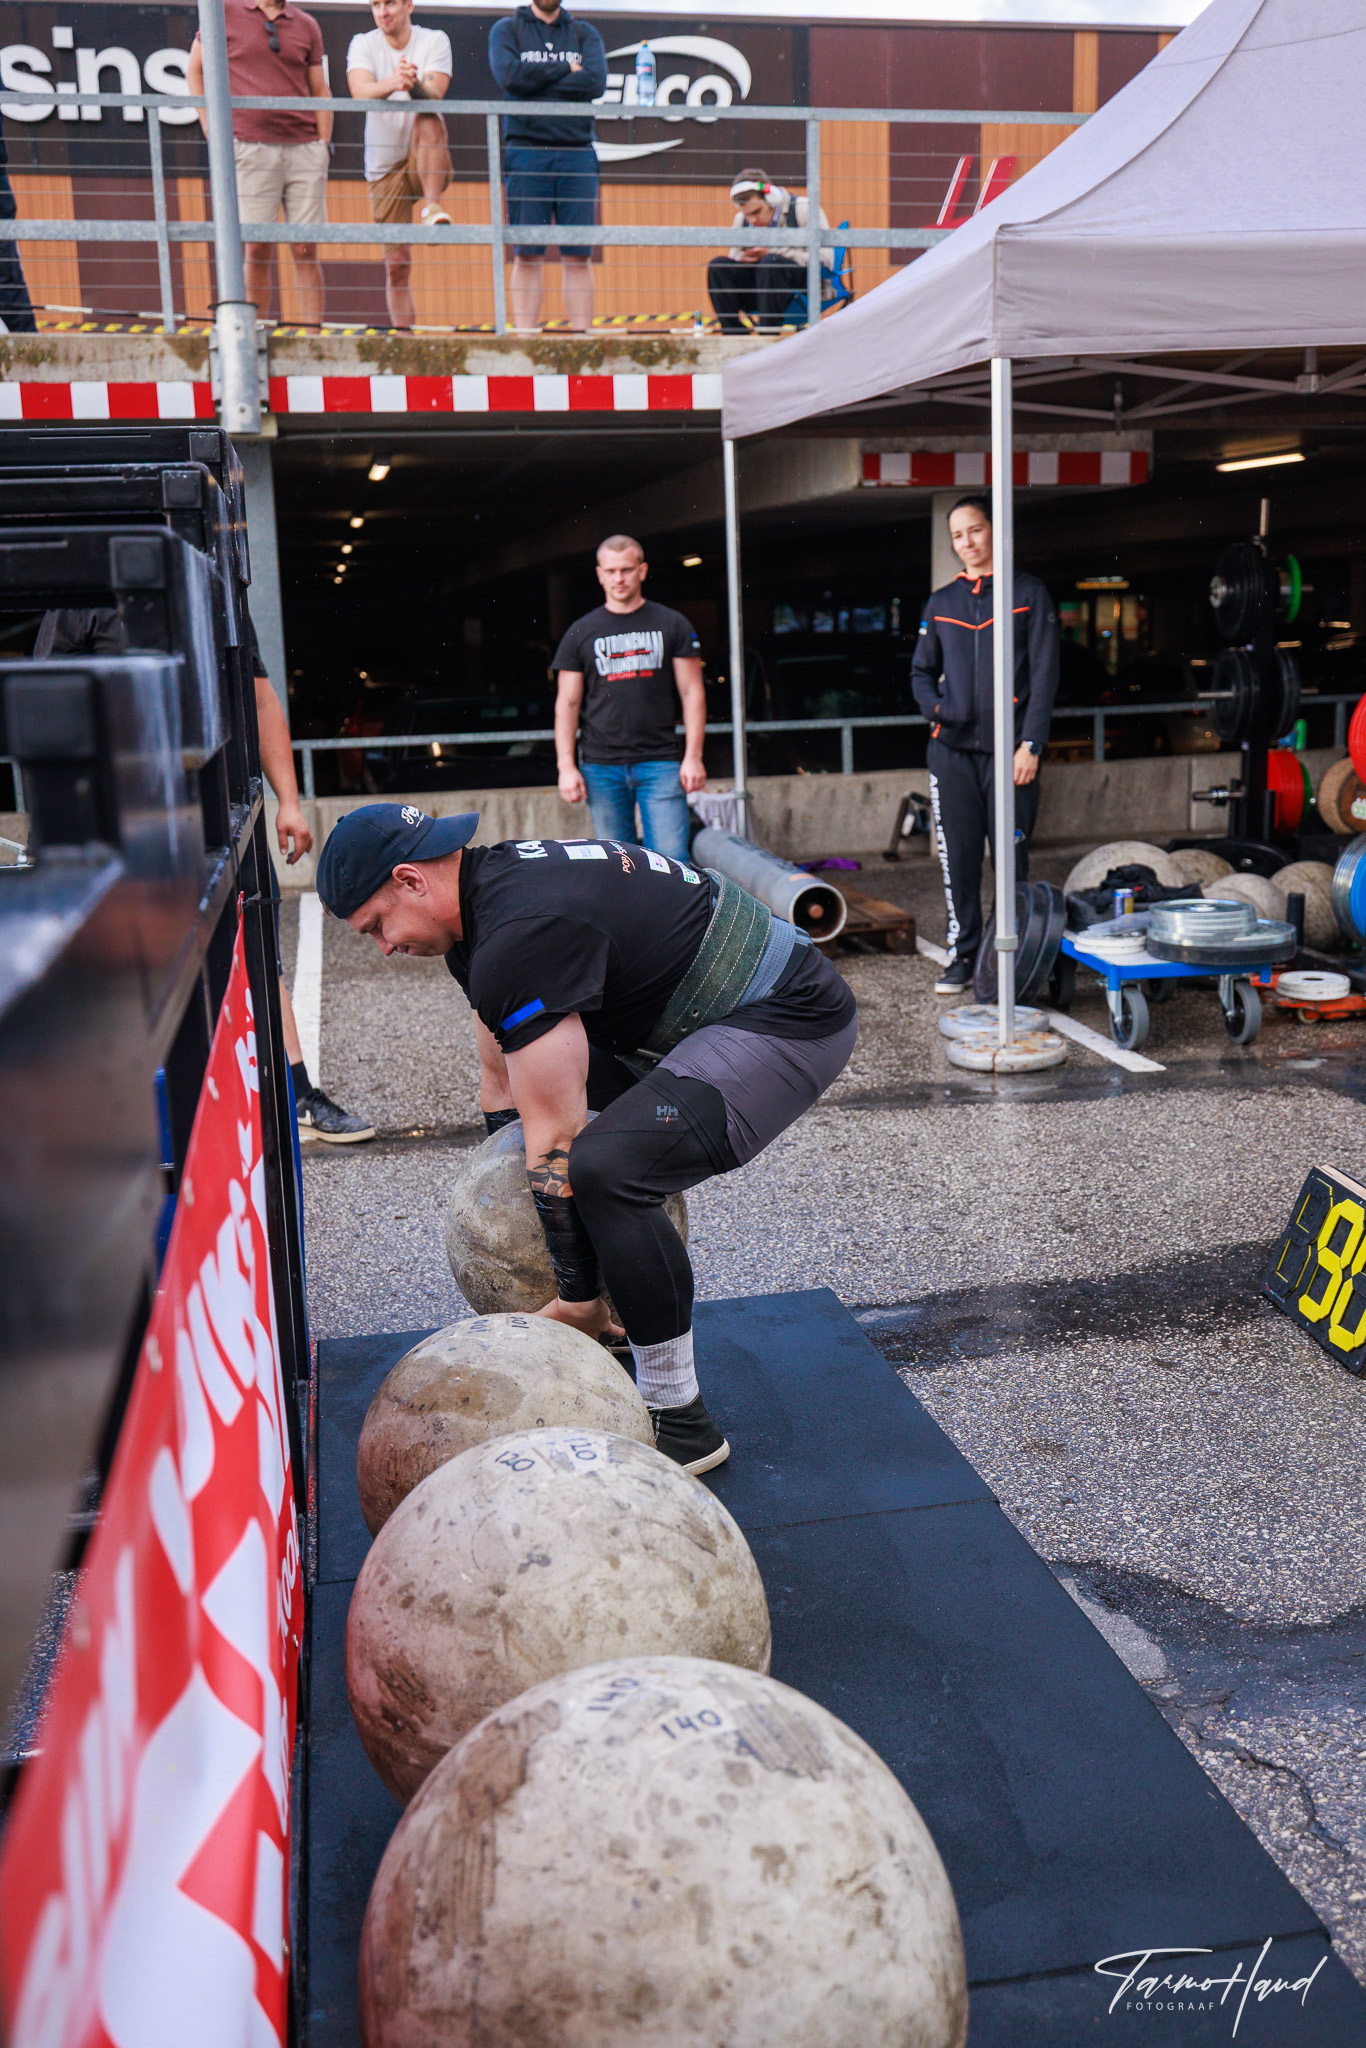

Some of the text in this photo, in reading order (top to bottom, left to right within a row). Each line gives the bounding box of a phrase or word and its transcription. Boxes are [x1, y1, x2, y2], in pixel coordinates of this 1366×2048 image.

[495, 1450, 536, 1473] 120
[587, 1677, 639, 1711] 140
[661, 1709, 722, 1739] 140
